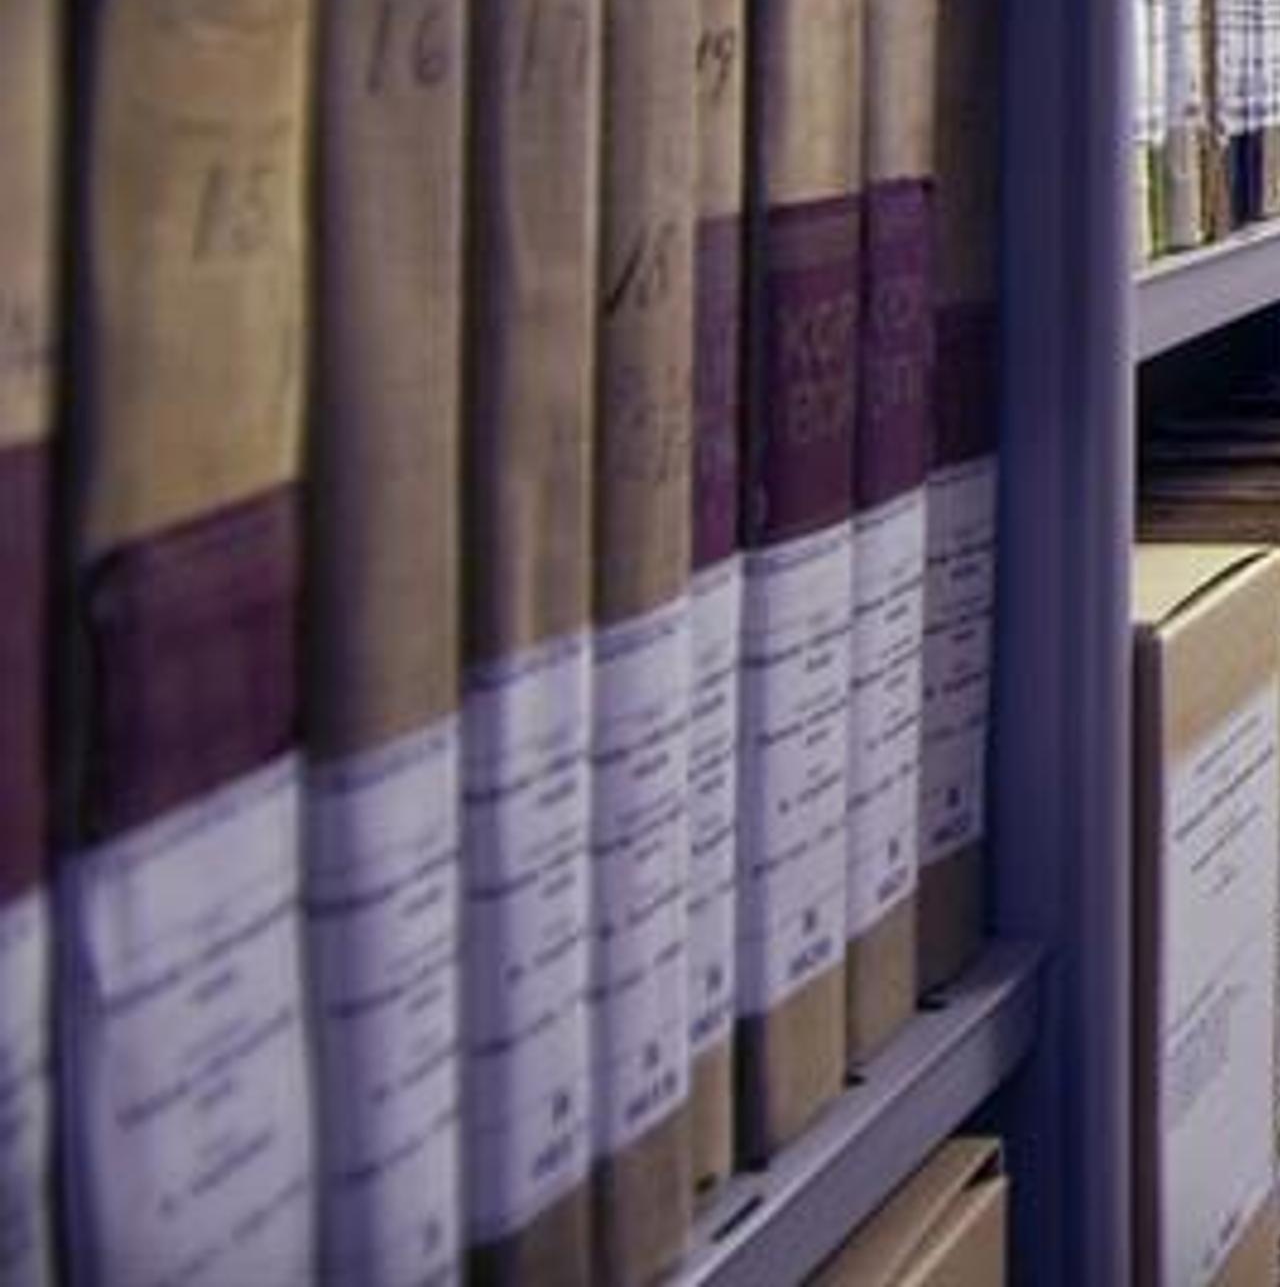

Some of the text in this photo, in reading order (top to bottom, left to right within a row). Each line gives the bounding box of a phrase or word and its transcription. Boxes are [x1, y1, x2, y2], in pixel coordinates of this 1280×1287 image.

[696, 28, 735, 110] 19
[193, 158, 279, 263] 15
[604, 219, 677, 316] 18
